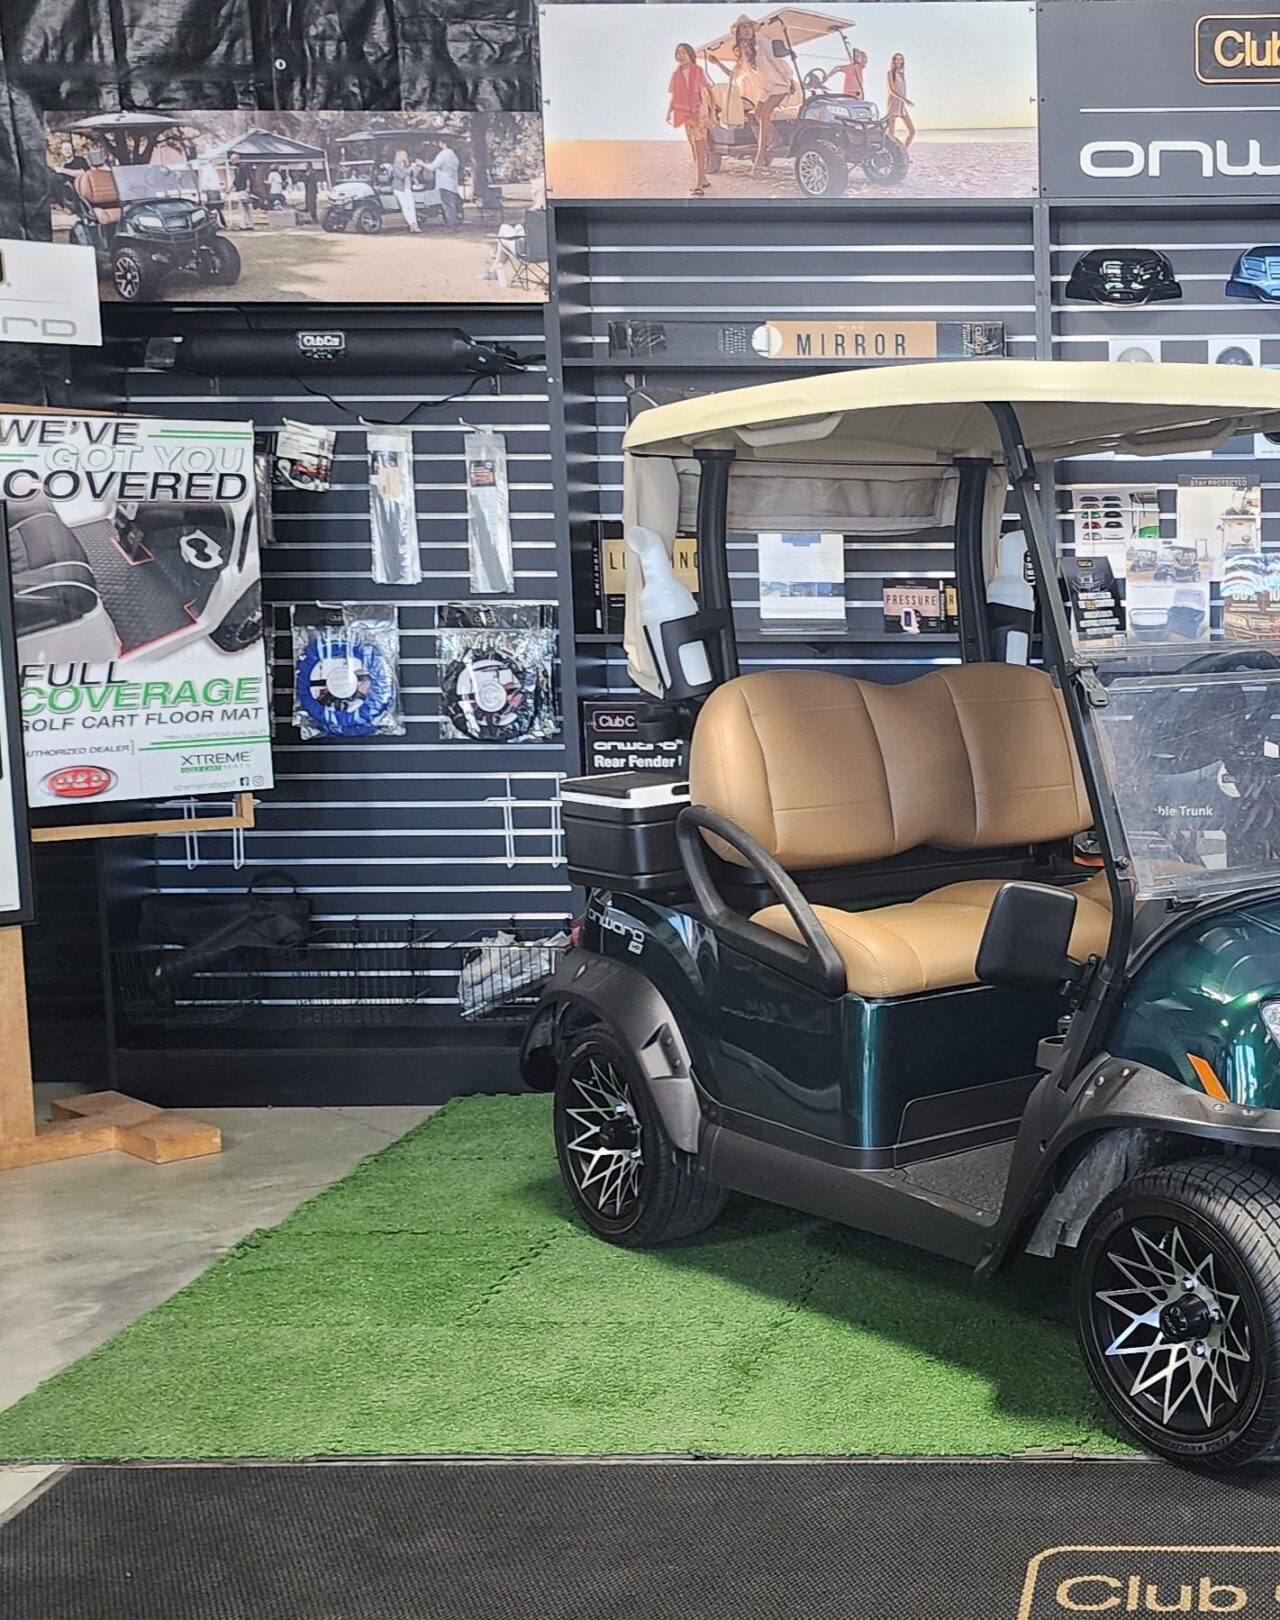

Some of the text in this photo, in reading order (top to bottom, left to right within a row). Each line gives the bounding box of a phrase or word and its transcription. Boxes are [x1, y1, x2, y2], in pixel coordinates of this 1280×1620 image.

[796, 333, 906, 356] MIRROR
[0, 419, 139, 447] WE'VE
[44, 443, 245, 473] GOT YOU
[3, 469, 249, 503] COVERED
[1190, 479, 1248, 488] STAY PROTECTED
[886, 594, 937, 606] PRESSURE
[21, 661, 128, 688] FULL
[21, 677, 263, 717] COVERAGE
[22, 707, 265, 733] GOLF CART FLOOR MAT
[599, 715, 624, 727] Club
[181, 751, 251, 767] XTREME
[593, 754, 676, 768] Rear Fender
[1179, 805, 1213, 817] Trunk
[1055, 1574, 1249, 1613] Club
